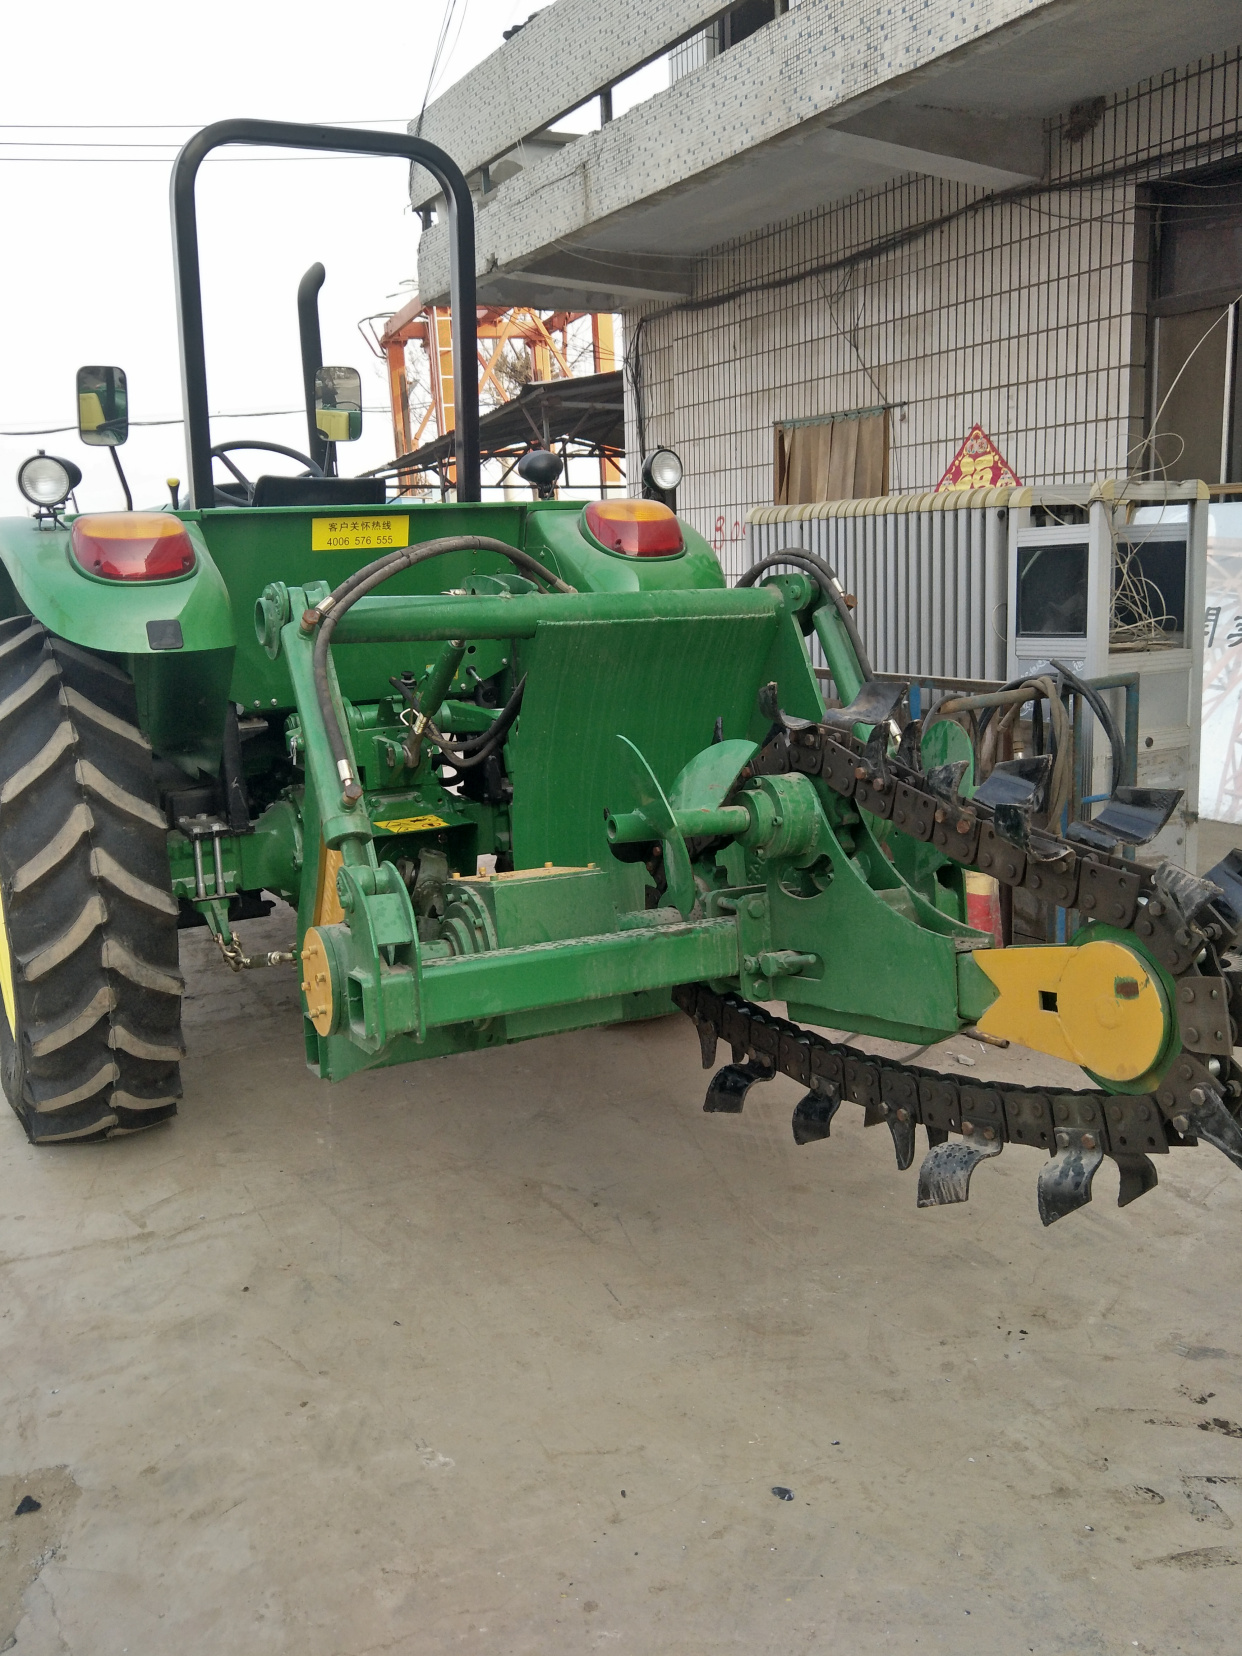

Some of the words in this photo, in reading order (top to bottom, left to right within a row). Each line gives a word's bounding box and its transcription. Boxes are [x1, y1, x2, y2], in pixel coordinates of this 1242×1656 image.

[328, 521, 392, 532] 客户关怀热线
[326, 537, 350, 546] 4006
[355, 536, 372, 545] 576
[376, 535, 393, 545] 555
